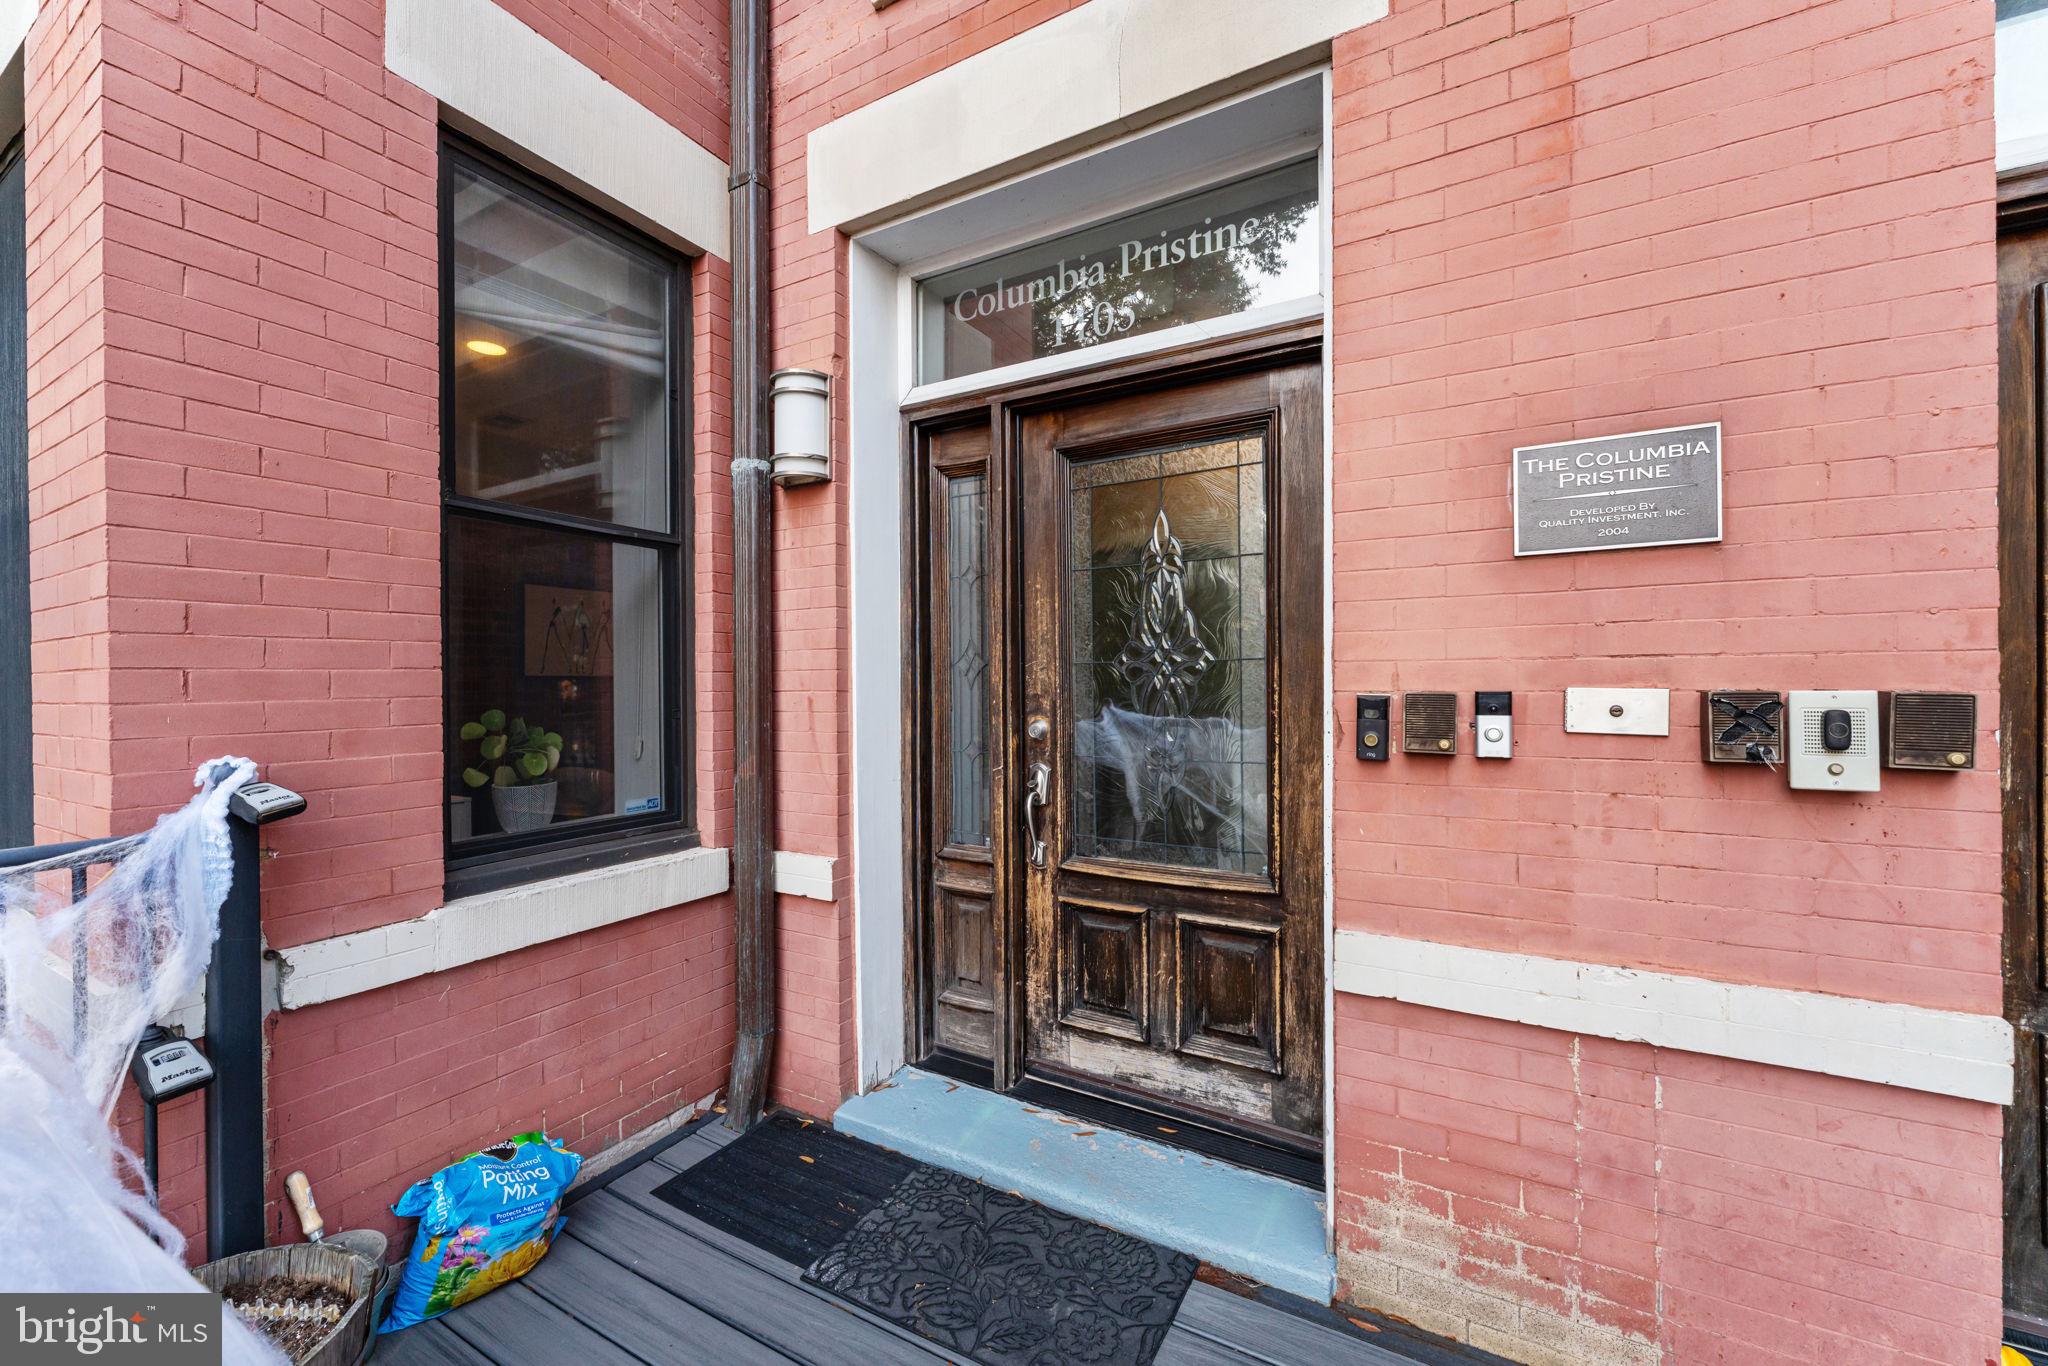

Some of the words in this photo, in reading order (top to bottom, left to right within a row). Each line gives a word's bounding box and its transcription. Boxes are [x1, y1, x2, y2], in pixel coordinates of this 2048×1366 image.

[954, 254, 1106, 322] Columbia
[1118, 216, 1260, 279] Pristine
[1049, 296, 1137, 348] 1105
[1521, 457, 1569, 475] THE
[1575, 440, 1711, 469] COLUMBIA
[1558, 464, 1671, 488] PRISTINE
[1538, 517, 1584, 528] QUALITY
[1665, 508, 1690, 516] INC.
[1569, 503, 1636, 517] DEVELOPED
[1639, 502, 1656, 511] BY
[1597, 526, 1630, 536] 2004
[161, 1066, 201, 1083] Master
[481, 1166, 550, 1189] Potting
[502, 1182, 538, 1205] Mix
[496, 1208, 522, 1220] Protects
[523, 1201, 545, 1212] Against
